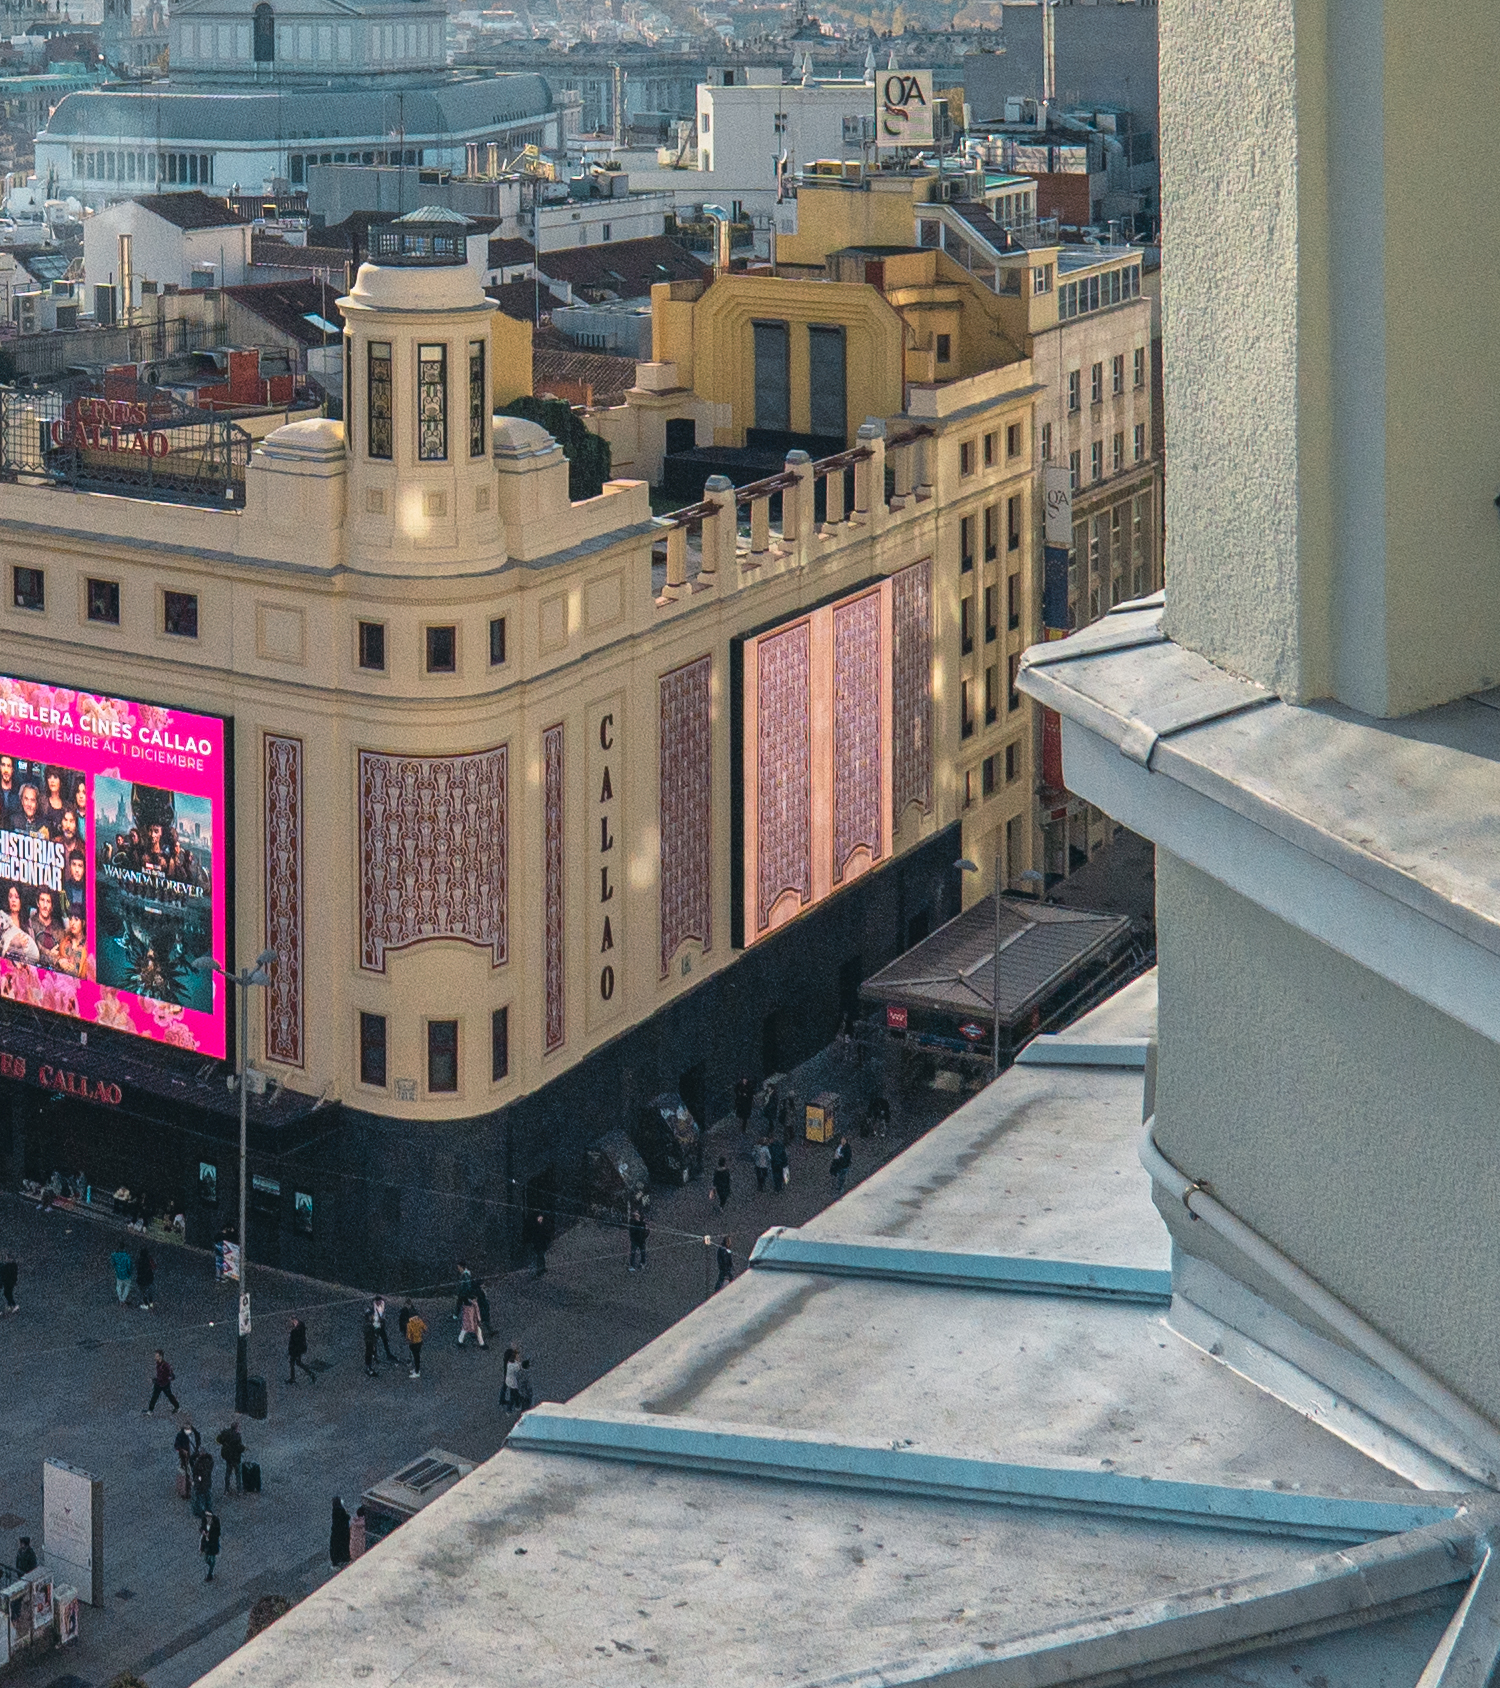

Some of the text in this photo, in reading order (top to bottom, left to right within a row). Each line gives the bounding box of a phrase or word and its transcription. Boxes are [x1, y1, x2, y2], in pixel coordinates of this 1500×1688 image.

[51, 419, 169, 458] CALLAO
[8, 719, 21, 733] 25
[25, 723, 99, 749] NOVIEMBRE
[103, 741, 119, 754] AL
[122, 743, 127, 755] 1
[131, 746, 205, 771] DICIEMBRE
[79, 716, 133, 740] CINES
[138, 727, 212, 756] CALLAO
[10, 856, 62, 892] CONTAR
[599, 714, 614, 1001] CALLAO
[103, 864, 204, 898] WAKANDA FOREVER
[38, 1065, 123, 1105] CALLAO
